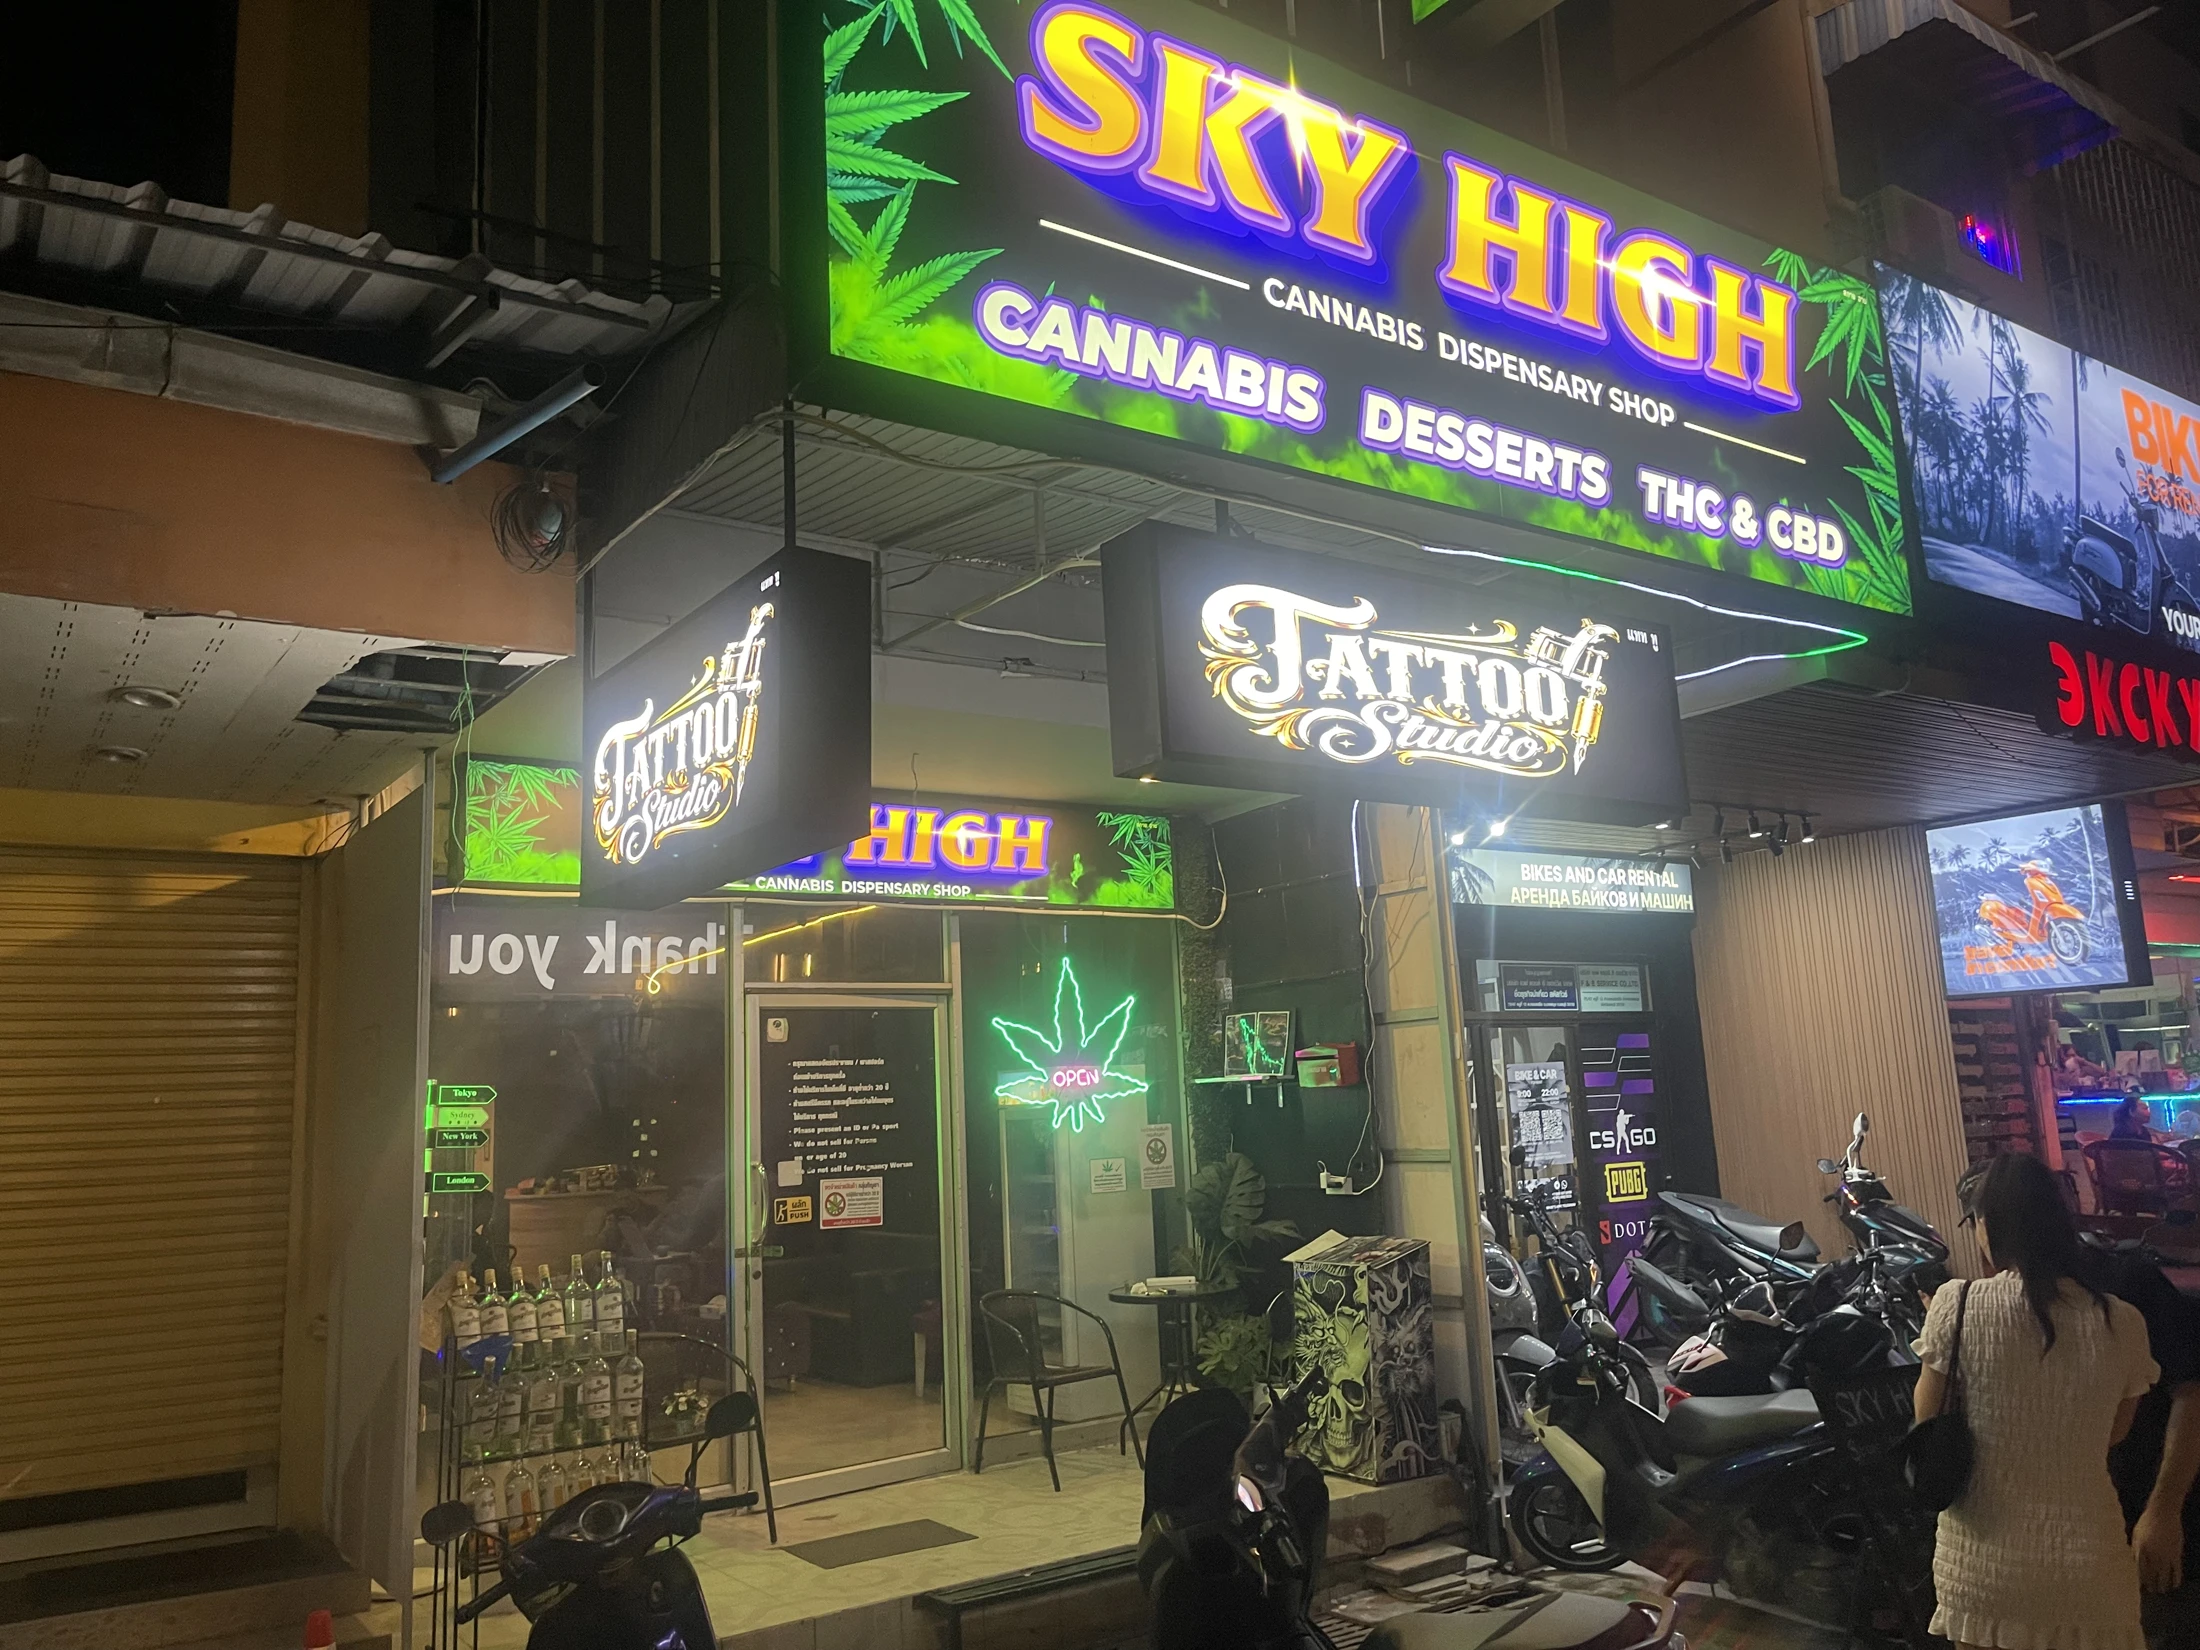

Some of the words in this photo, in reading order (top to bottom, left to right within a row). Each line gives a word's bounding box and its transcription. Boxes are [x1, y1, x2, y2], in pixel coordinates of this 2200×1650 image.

[1024, 4, 1410, 262] SKY
[1440, 155, 1800, 409] HIGH
[1264, 278, 1425, 351] CANNABIS
[1438, 333, 1603, 407] DISPENSARY
[1610, 386, 1676, 428] SHOP
[979, 287, 1325, 427] CANNABIS
[1362, 390, 1611, 504] DESSERTS
[1639, 467, 1725, 535] THC
[1731, 497, 1758, 545] &
[1768, 508, 1846, 567] CBD
[2121, 388, 2200, 485] BIK
[2136, 470, 2171, 508] FOR
[1307, 700, 1545, 763] Studio
[620, 775, 723, 864] Studio
[844, 804, 1052, 875] HIGH
[1520, 863, 1563, 883] BIKES
[1565, 866, 1595, 884] AND
[1597, 867, 1627, 886] CAR
[1628, 869, 1679, 888] RENTAL
[754, 876, 835, 894] CANNABIS
[841, 880, 931, 897] DISPENSARY
[933, 884, 971, 898] SHOP
[1511, 887, 1571, 908] АРЕНДА
[1572, 886, 1629, 908] БАЙКОВ
[1630, 892, 1640, 908] И
[1642, 892, 1694, 911] МАШИН
[1052, 1068, 1100, 1087] OPEN
[1514, 1070, 1532, 1081] BIKE
[1534, 1070, 1540, 1080] &
[1540, 1069, 1558, 1080] CAR
[452, 1089, 478, 1098] Tokyo
[1517, 1090, 1532, 1098] 9:00
[1541, 1088, 1559, 1097] 22:00
[450, 1111, 475, 1119] Sydney
[442, 1132, 459, 1140] New
[460, 1132, 478, 1140] York
[816, 1126, 842, 1134] present
[853, 1124, 861, 1132] ID
[1589, 1130, 1616, 1149] CS
[1630, 1128, 1656, 1146] GO
[830, 1138, 842, 1146] sell
[815, 1154, 828, 1162] age
[830, 1164, 842, 1172] sell
[843, 1164, 854, 1172] for
[446, 1176, 476, 1185] London
[1610, 1169, 1642, 1196] PUBG
[792, 1200, 807, 1208] ผลัก
[790, 1212, 809, 1220] PUSH
[1615, 1220, 1653, 1239] DOT
